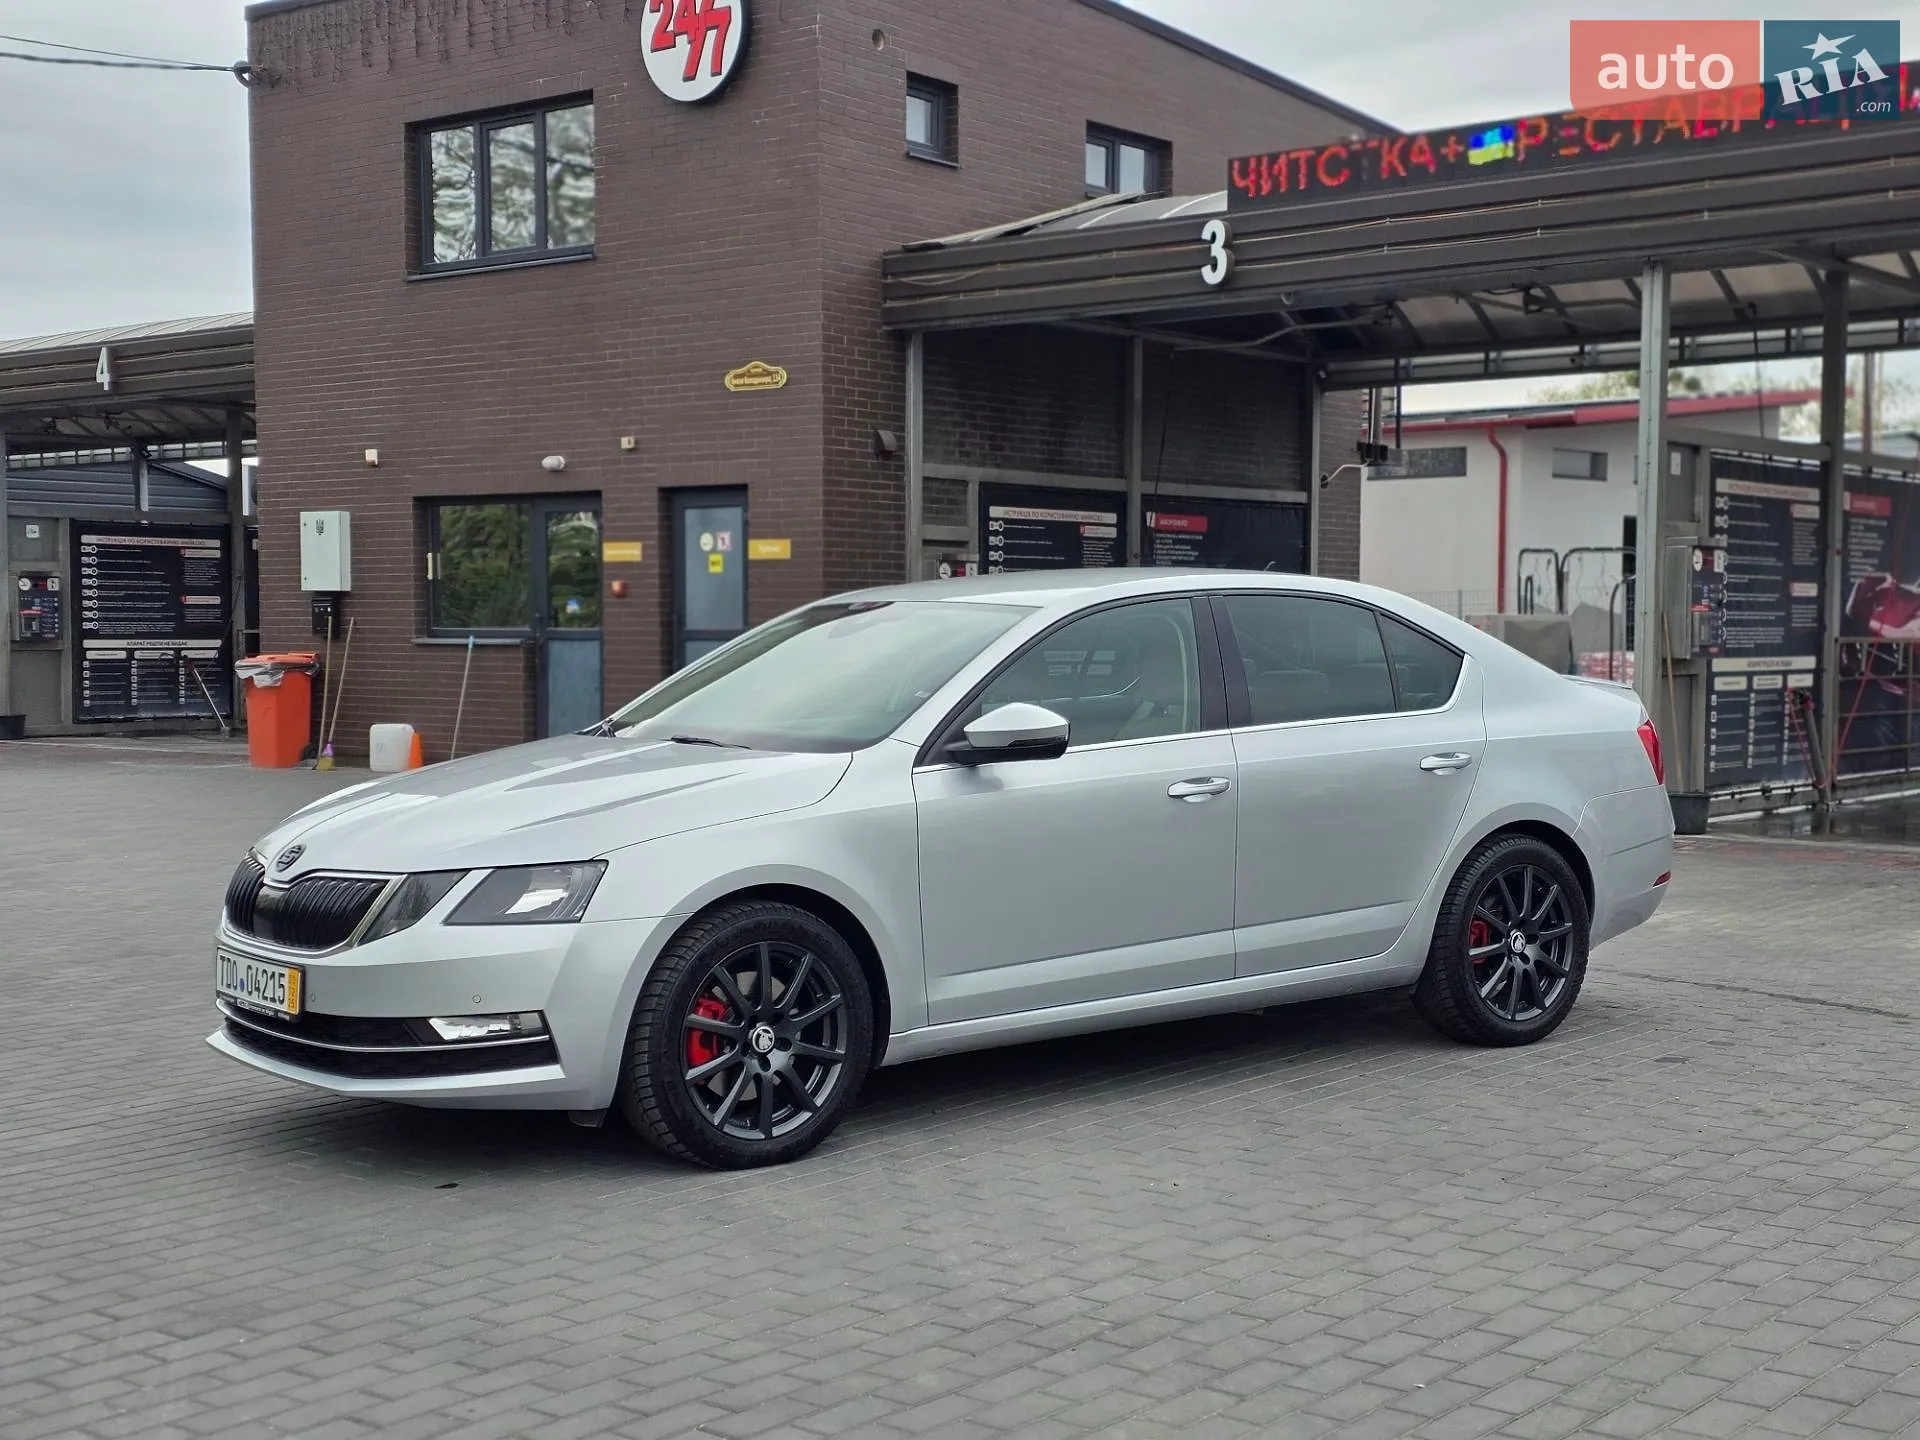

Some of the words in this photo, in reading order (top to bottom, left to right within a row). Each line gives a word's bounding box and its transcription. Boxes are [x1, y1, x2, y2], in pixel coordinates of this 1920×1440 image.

[650, 0, 732, 82] 24/7
[1201, 219, 1228, 285] 3
[96, 346, 110, 391] 4
[246, 964, 286, 1005] 04215
